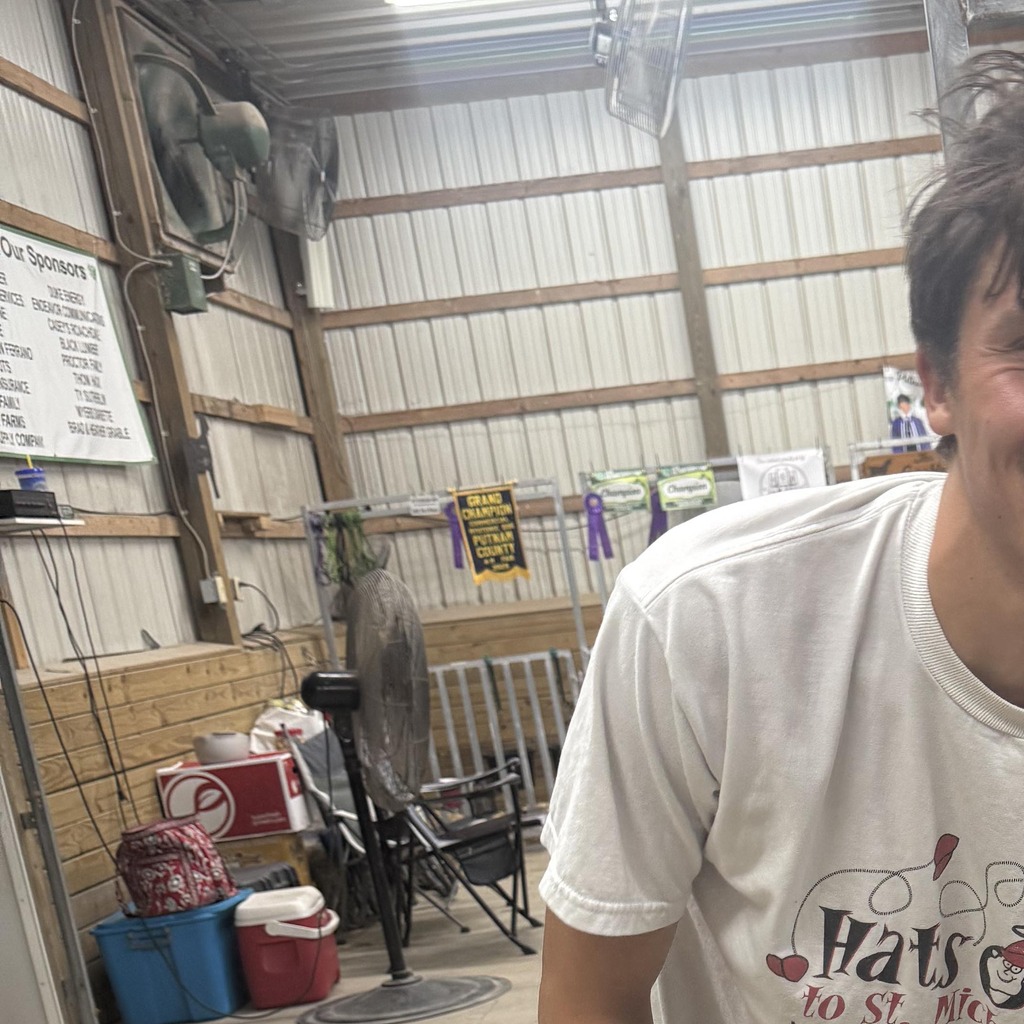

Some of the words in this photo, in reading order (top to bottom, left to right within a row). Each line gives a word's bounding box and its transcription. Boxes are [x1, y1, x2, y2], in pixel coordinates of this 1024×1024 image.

[0, 236, 25, 263] Our
[26, 245, 87, 281] Sponsors
[0, 413, 27, 430] FARMS
[466, 492, 503, 508] GRAND
[461, 504, 513, 521] CHAMPION
[472, 531, 514, 548] PUTNAM
[476, 542, 516, 559] COUNTY
[813, 906, 975, 989] Hats
[801, 984, 846, 1021] to
